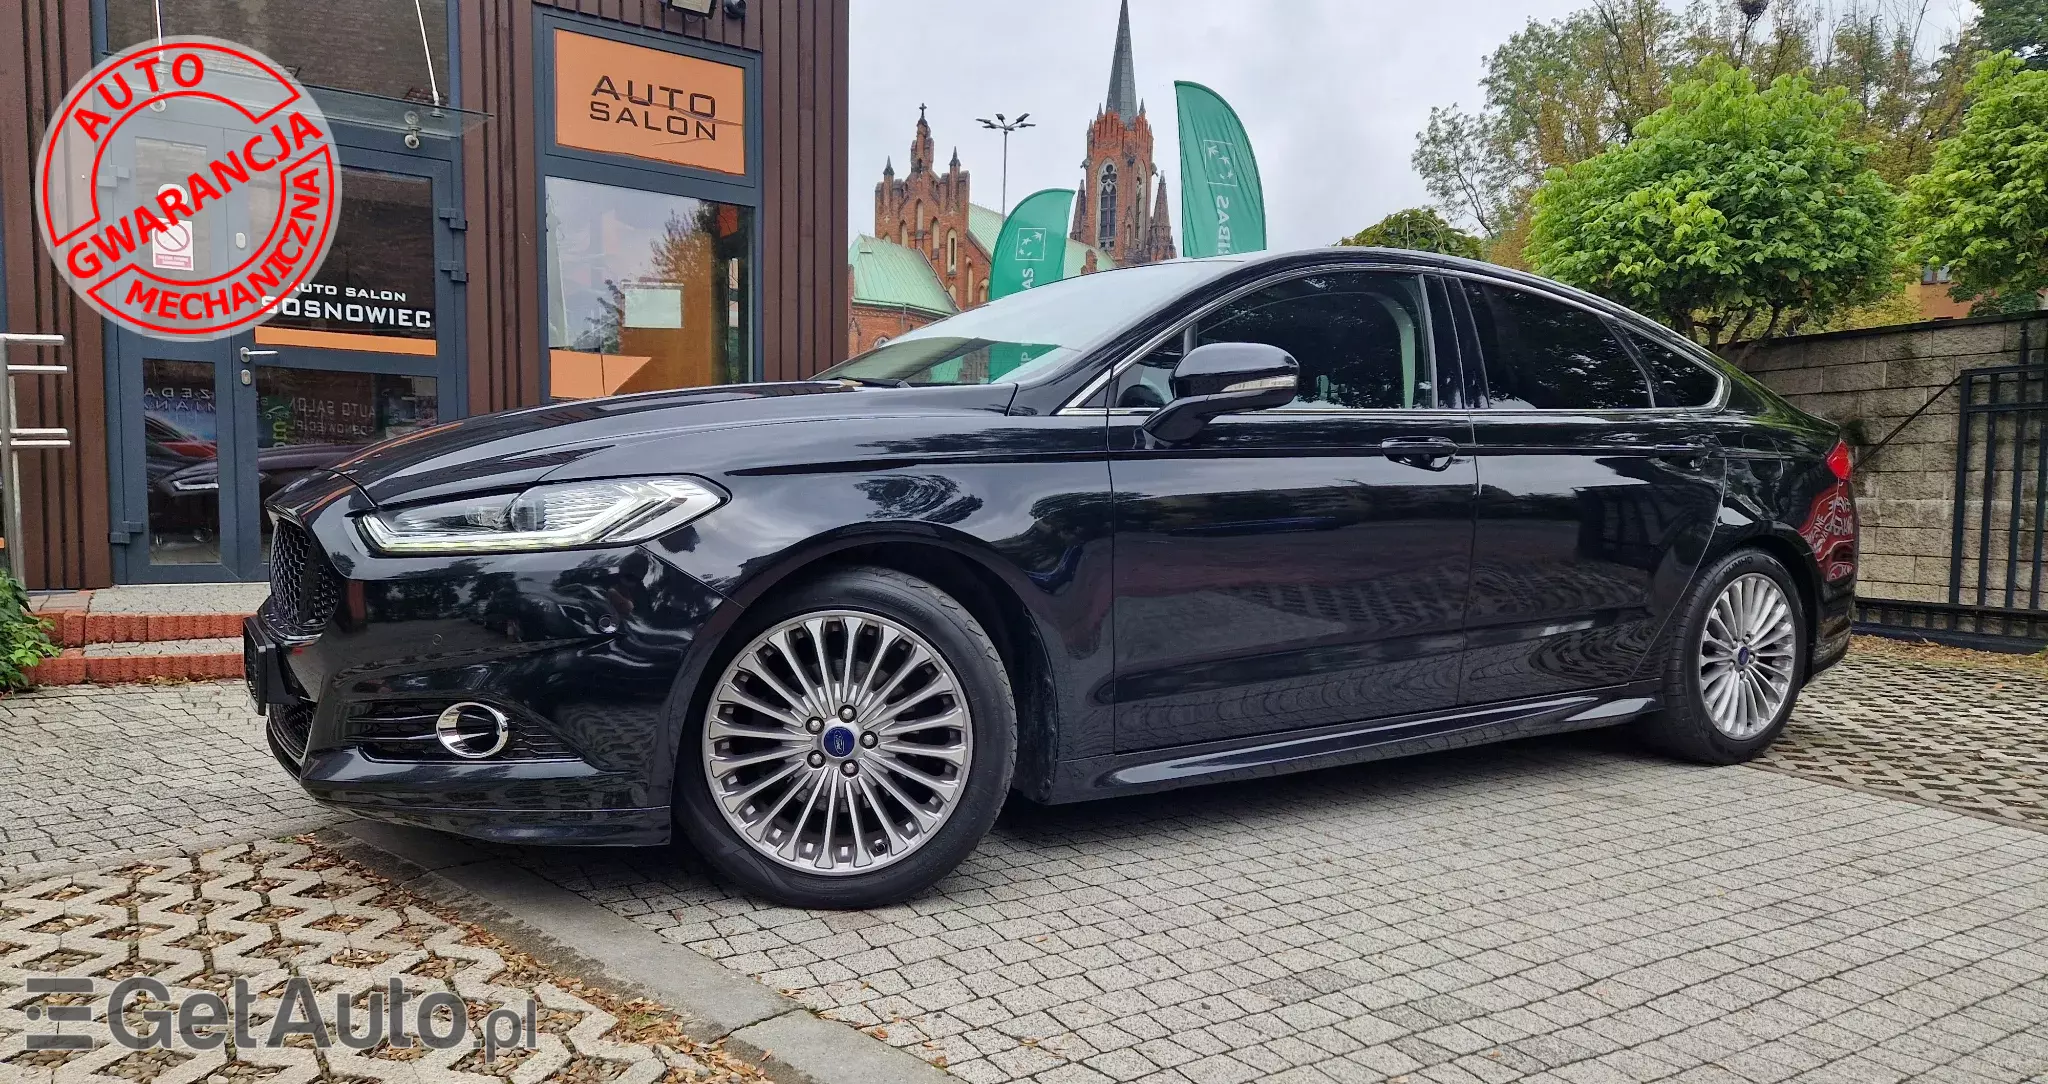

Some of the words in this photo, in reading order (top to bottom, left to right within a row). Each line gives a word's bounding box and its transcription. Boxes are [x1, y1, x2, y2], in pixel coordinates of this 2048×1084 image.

[591, 75, 716, 118] AUTO
[589, 100, 716, 141] SALON
[260, 295, 431, 328] SOSNOWIEC
[345, 287, 407, 302] SALON
